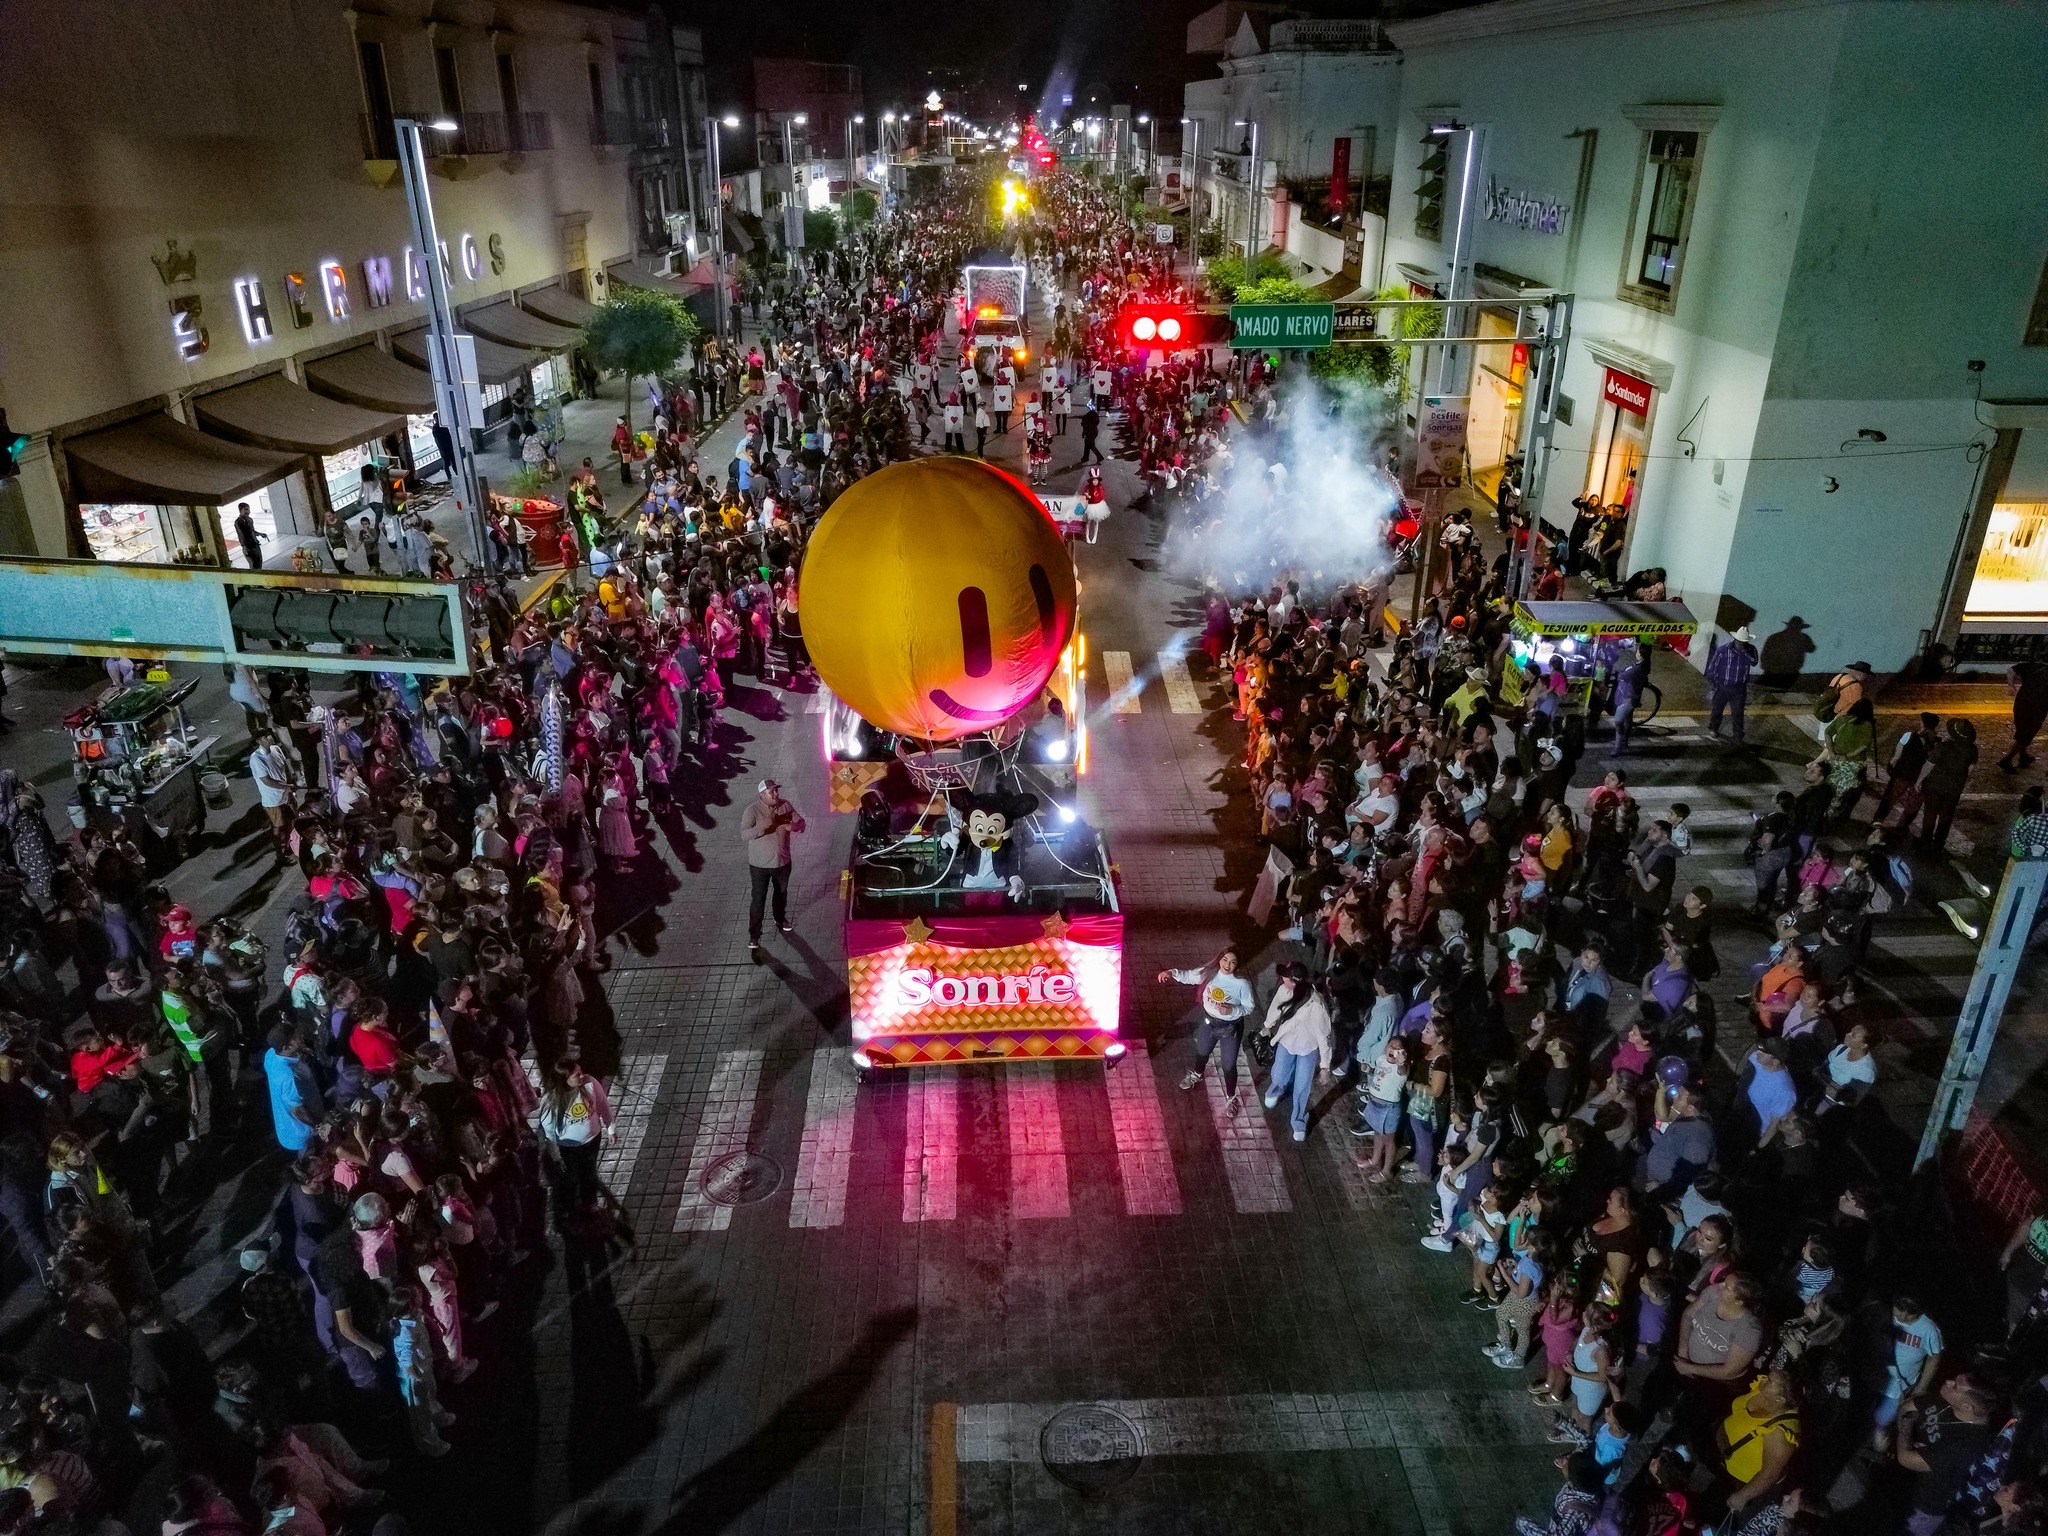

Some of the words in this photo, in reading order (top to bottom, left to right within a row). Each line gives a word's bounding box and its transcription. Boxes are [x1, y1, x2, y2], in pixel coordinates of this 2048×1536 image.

[234, 232, 506, 342] HERMANOS
[1235, 315, 1279, 337] AMADO
[1286, 315, 1329, 336] NERVO
[1614, 382, 1646, 408] Santander
[1431, 412, 1461, 420] Desfile
[1600, 624, 1635, 633] AGUAS
[1637, 624, 1685, 633] HELADAS
[898, 966, 1077, 1007] Sonríe
[1925, 1404, 1941, 1443] BOSS
